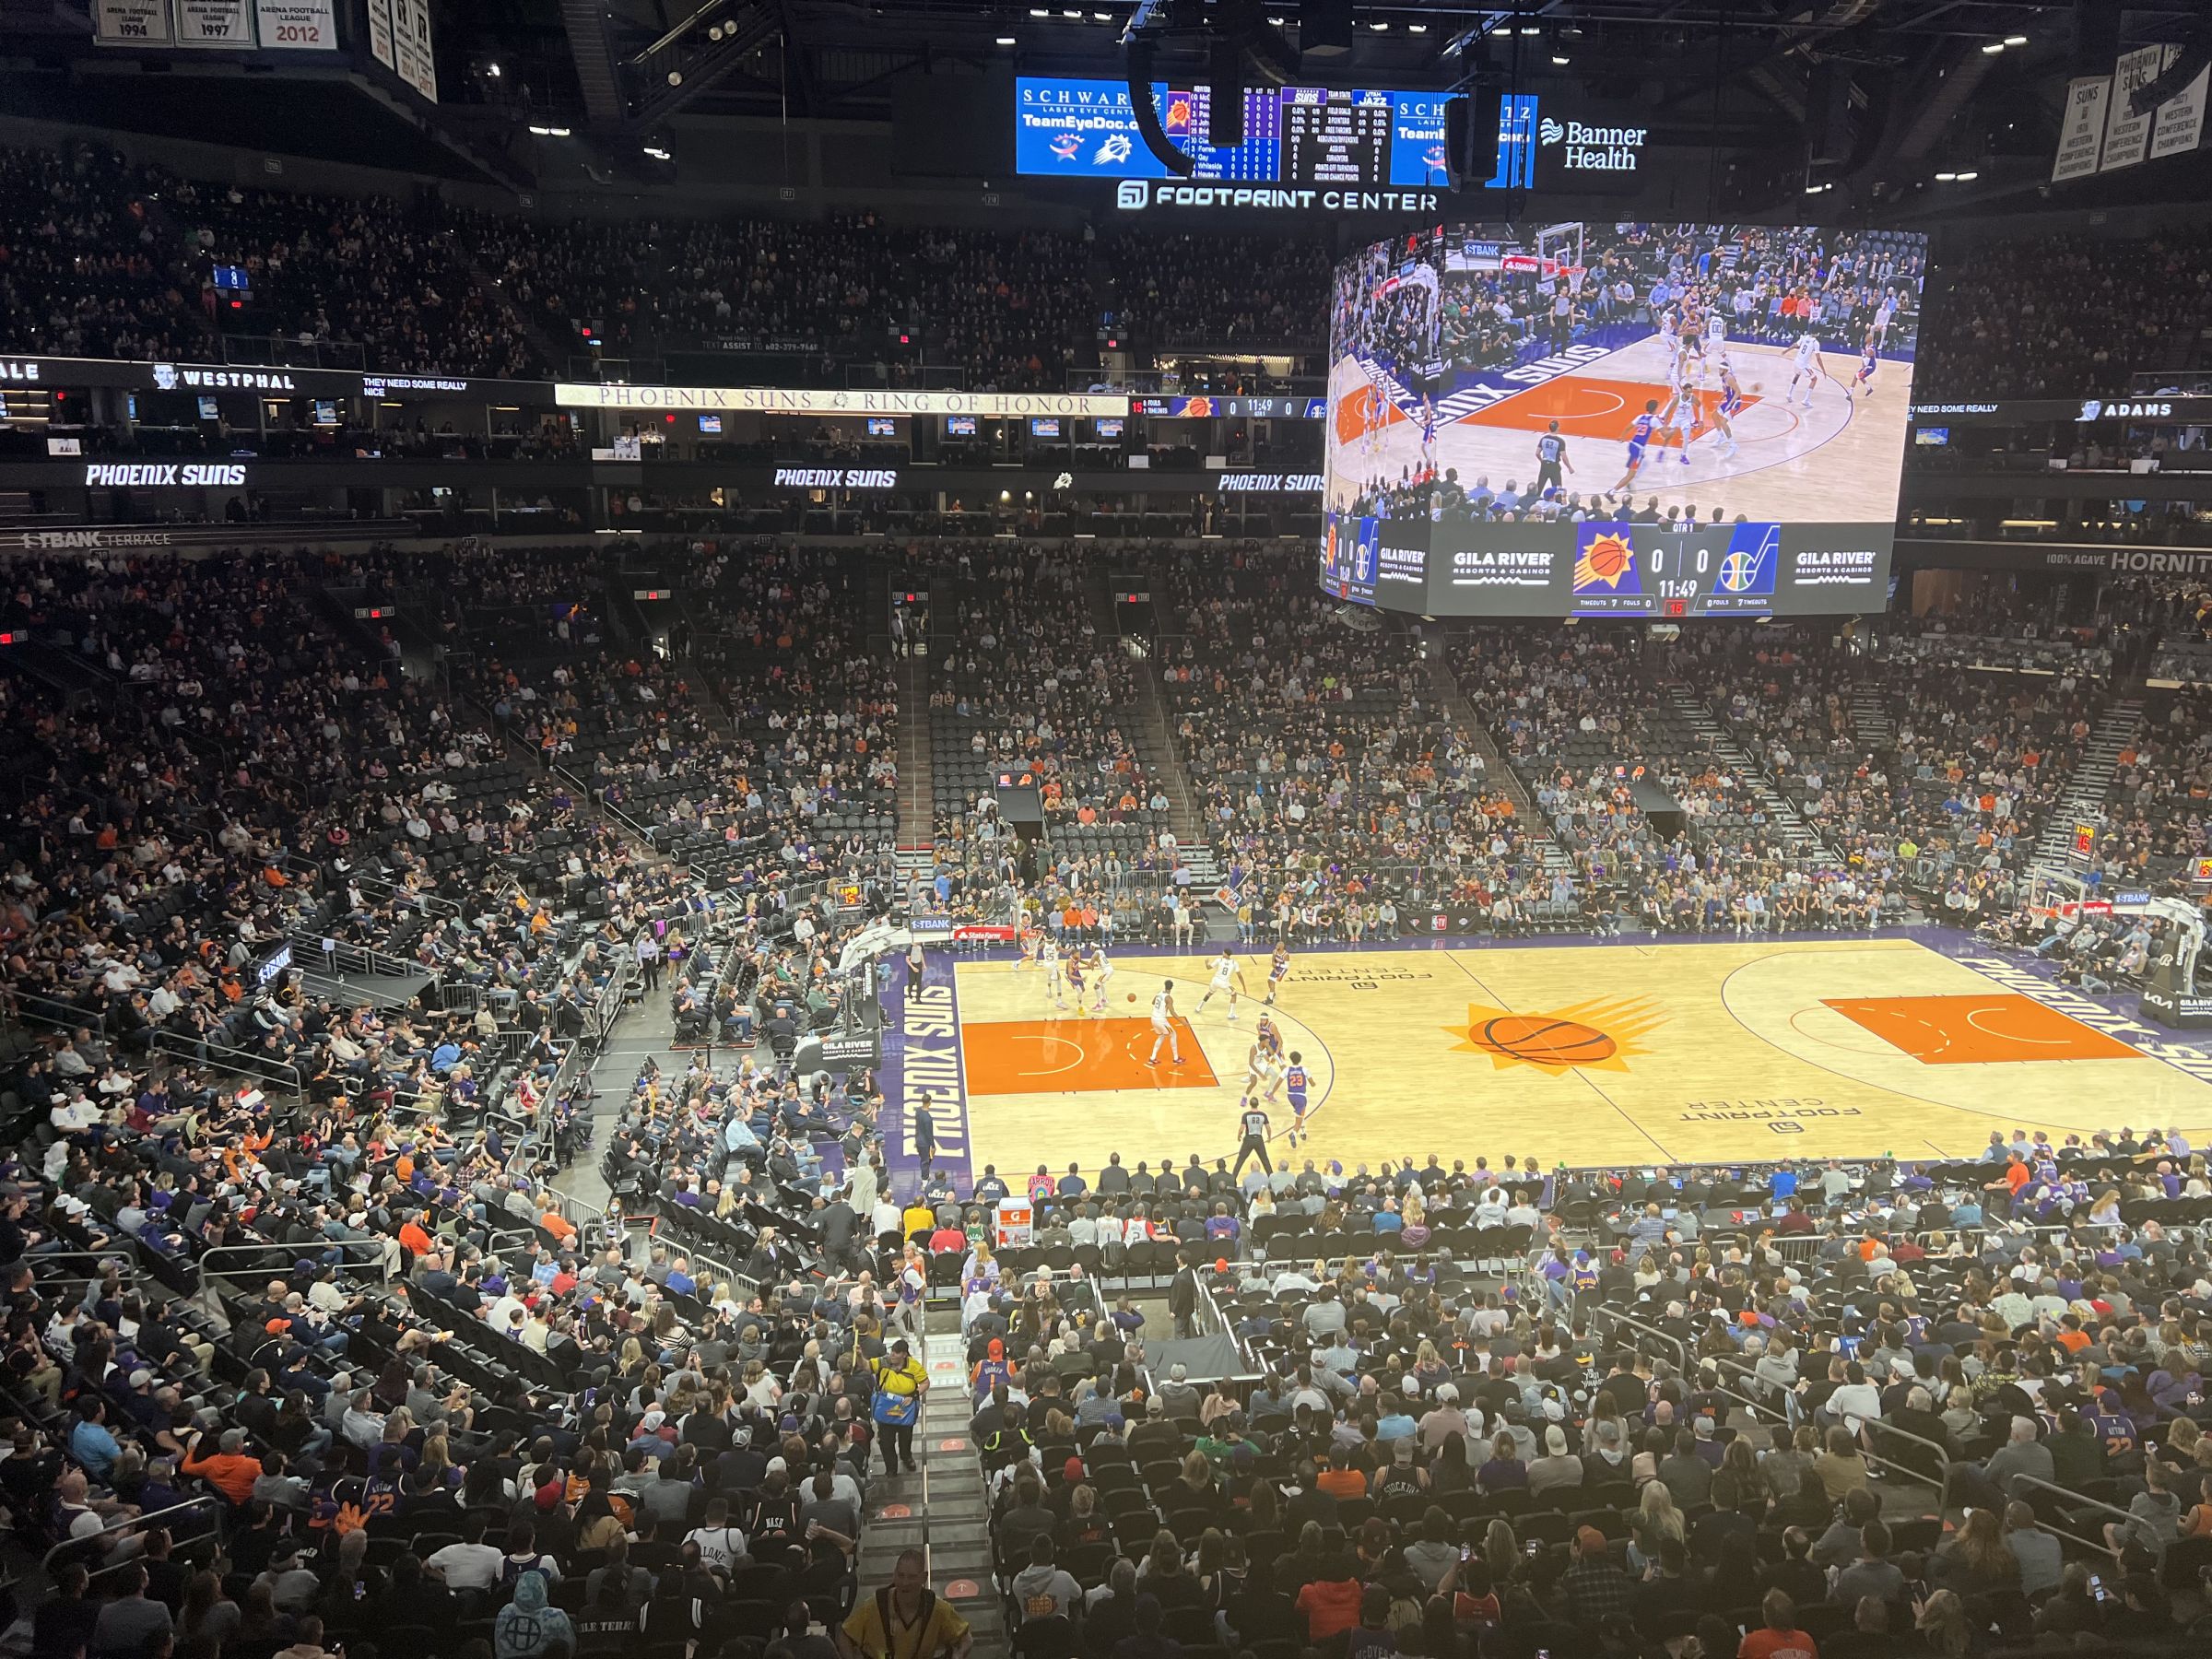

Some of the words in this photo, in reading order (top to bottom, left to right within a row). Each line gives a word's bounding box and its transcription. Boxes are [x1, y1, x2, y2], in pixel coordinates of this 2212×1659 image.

[203, 14, 225, 22] LEAGUE
[119, 24, 147, 36] 1994
[201, 24, 230, 36] 1997
[276, 26, 319, 41] 2012
[2119, 51, 2157, 76] PHOENIX
[2123, 71, 2147, 91] SUNS
[1023, 89, 1161, 106] SCHWARZ
[1359, 97, 1387, 105] JAZZ
[2076, 86, 2099, 105] SUNS
[2164, 106, 2193, 121] WESTERN
[1568, 122, 1647, 146] Banner
[2112, 121, 2141, 135] WESTERN
[2157, 118, 2197, 136] CONFERENCE
[2066, 135, 2093, 148] WESTERN
[2157, 133, 2194, 150] CHAMPIONS
[1564, 146, 1636, 171] Health
[2059, 146, 2096, 163] CONFERENCE
[1157, 186, 1315, 208] FOOTPRINT
[1323, 190, 1438, 210] CENTER
[1712, 324, 1721, 333] 00
[1503, 344, 1611, 383] SUNS
[182, 371, 295, 389] WESTPHAL
[363, 377, 386, 388] THEY
[387, 378, 410, 389] NEED
[411, 379, 436, 390] SOME
[437, 380, 467, 391] REALLY
[363, 388, 385, 397] NICE
[599, 387, 727, 407] PHOENIX
[744, 391, 811, 408] SUNS
[864, 393, 929, 411] RING
[947, 395, 979, 411] OF
[995, 395, 1091, 413] HONOR
[1247, 398, 1273, 412] 11:49
[1132, 402, 1143, 413] 15
[1230, 402, 1236, 415] 0
[1285, 402, 1292, 415] 0
[1917, 405, 1939, 413] NEED
[1941, 404, 1965, 413] SOME
[1966, 404, 1998, 413] REALLY
[2104, 404, 2171, 417] ADAMS
[1637, 424, 1648, 436] 23
[86, 465, 178, 486] PHOENIX
[182, 465, 246, 486] SUNS
[774, 469, 843, 487] PHOENIX
[845, 470, 897, 487] SUNS
[1218, 475, 1283, 490] PHOENIX
[1673, 524, 1688, 533] QTR
[105, 533, 171, 547] TERRACE
[1339, 538, 1343, 559] 0
[1349, 540, 1354, 561] 0
[1380, 547, 1398, 563] GILA
[1398, 549, 1425, 564] RIVER
[1453, 552, 1499, 566] GILA
[1500, 553, 1554, 566] RIVER
[1652, 549, 1663, 572] 0
[1697, 549, 1708, 573] 0
[1797, 552, 1830, 565] GILA
[1832, 551, 1876, 564] RIVER
[2047, 554, 2072, 564] 100%
[2075, 555, 2106, 565] AGAVE
[2111, 552, 2212, 573] HORNIT
[1659, 580, 1698, 598] 11:49
[1612, 598, 1618, 606] 7
[1645, 599, 1651, 608] 0
[1738, 598, 1743, 606] 7
[2077, 836, 2090, 852] 15
[2200, 866, 2209, 877] 15
[845, 894, 855, 904] 15
[1045, 952, 1053, 960] 25
[1222, 967, 1229, 975] 8
[1285, 973, 1433, 982] FOOTPRINT
[1296, 967, 1408, 975] CENTER
[1954, 958, 2160, 1037] PHOENIX
[903, 984, 955, 1038] SUNS
[822, 1041, 842, 1050] GILA
[844, 1041, 873, 1049] RIVER
[1289, 1076, 1303, 1087] 23
[902, 1045, 965, 1158] PHOENIX
[1686, 1098, 1824, 1110] CENTER
[1679, 1107, 1862, 1122] FOOTPRINT
[928, 1189, 945, 1198] JAZZ
[1010, 1211, 1020, 1222] G
[2106, 1438, 2132, 1457] 22
[369, 1493, 394, 1513] 22
[765, 1518, 783, 1528] NASH
[700, 1546, 726, 1563] LONE
